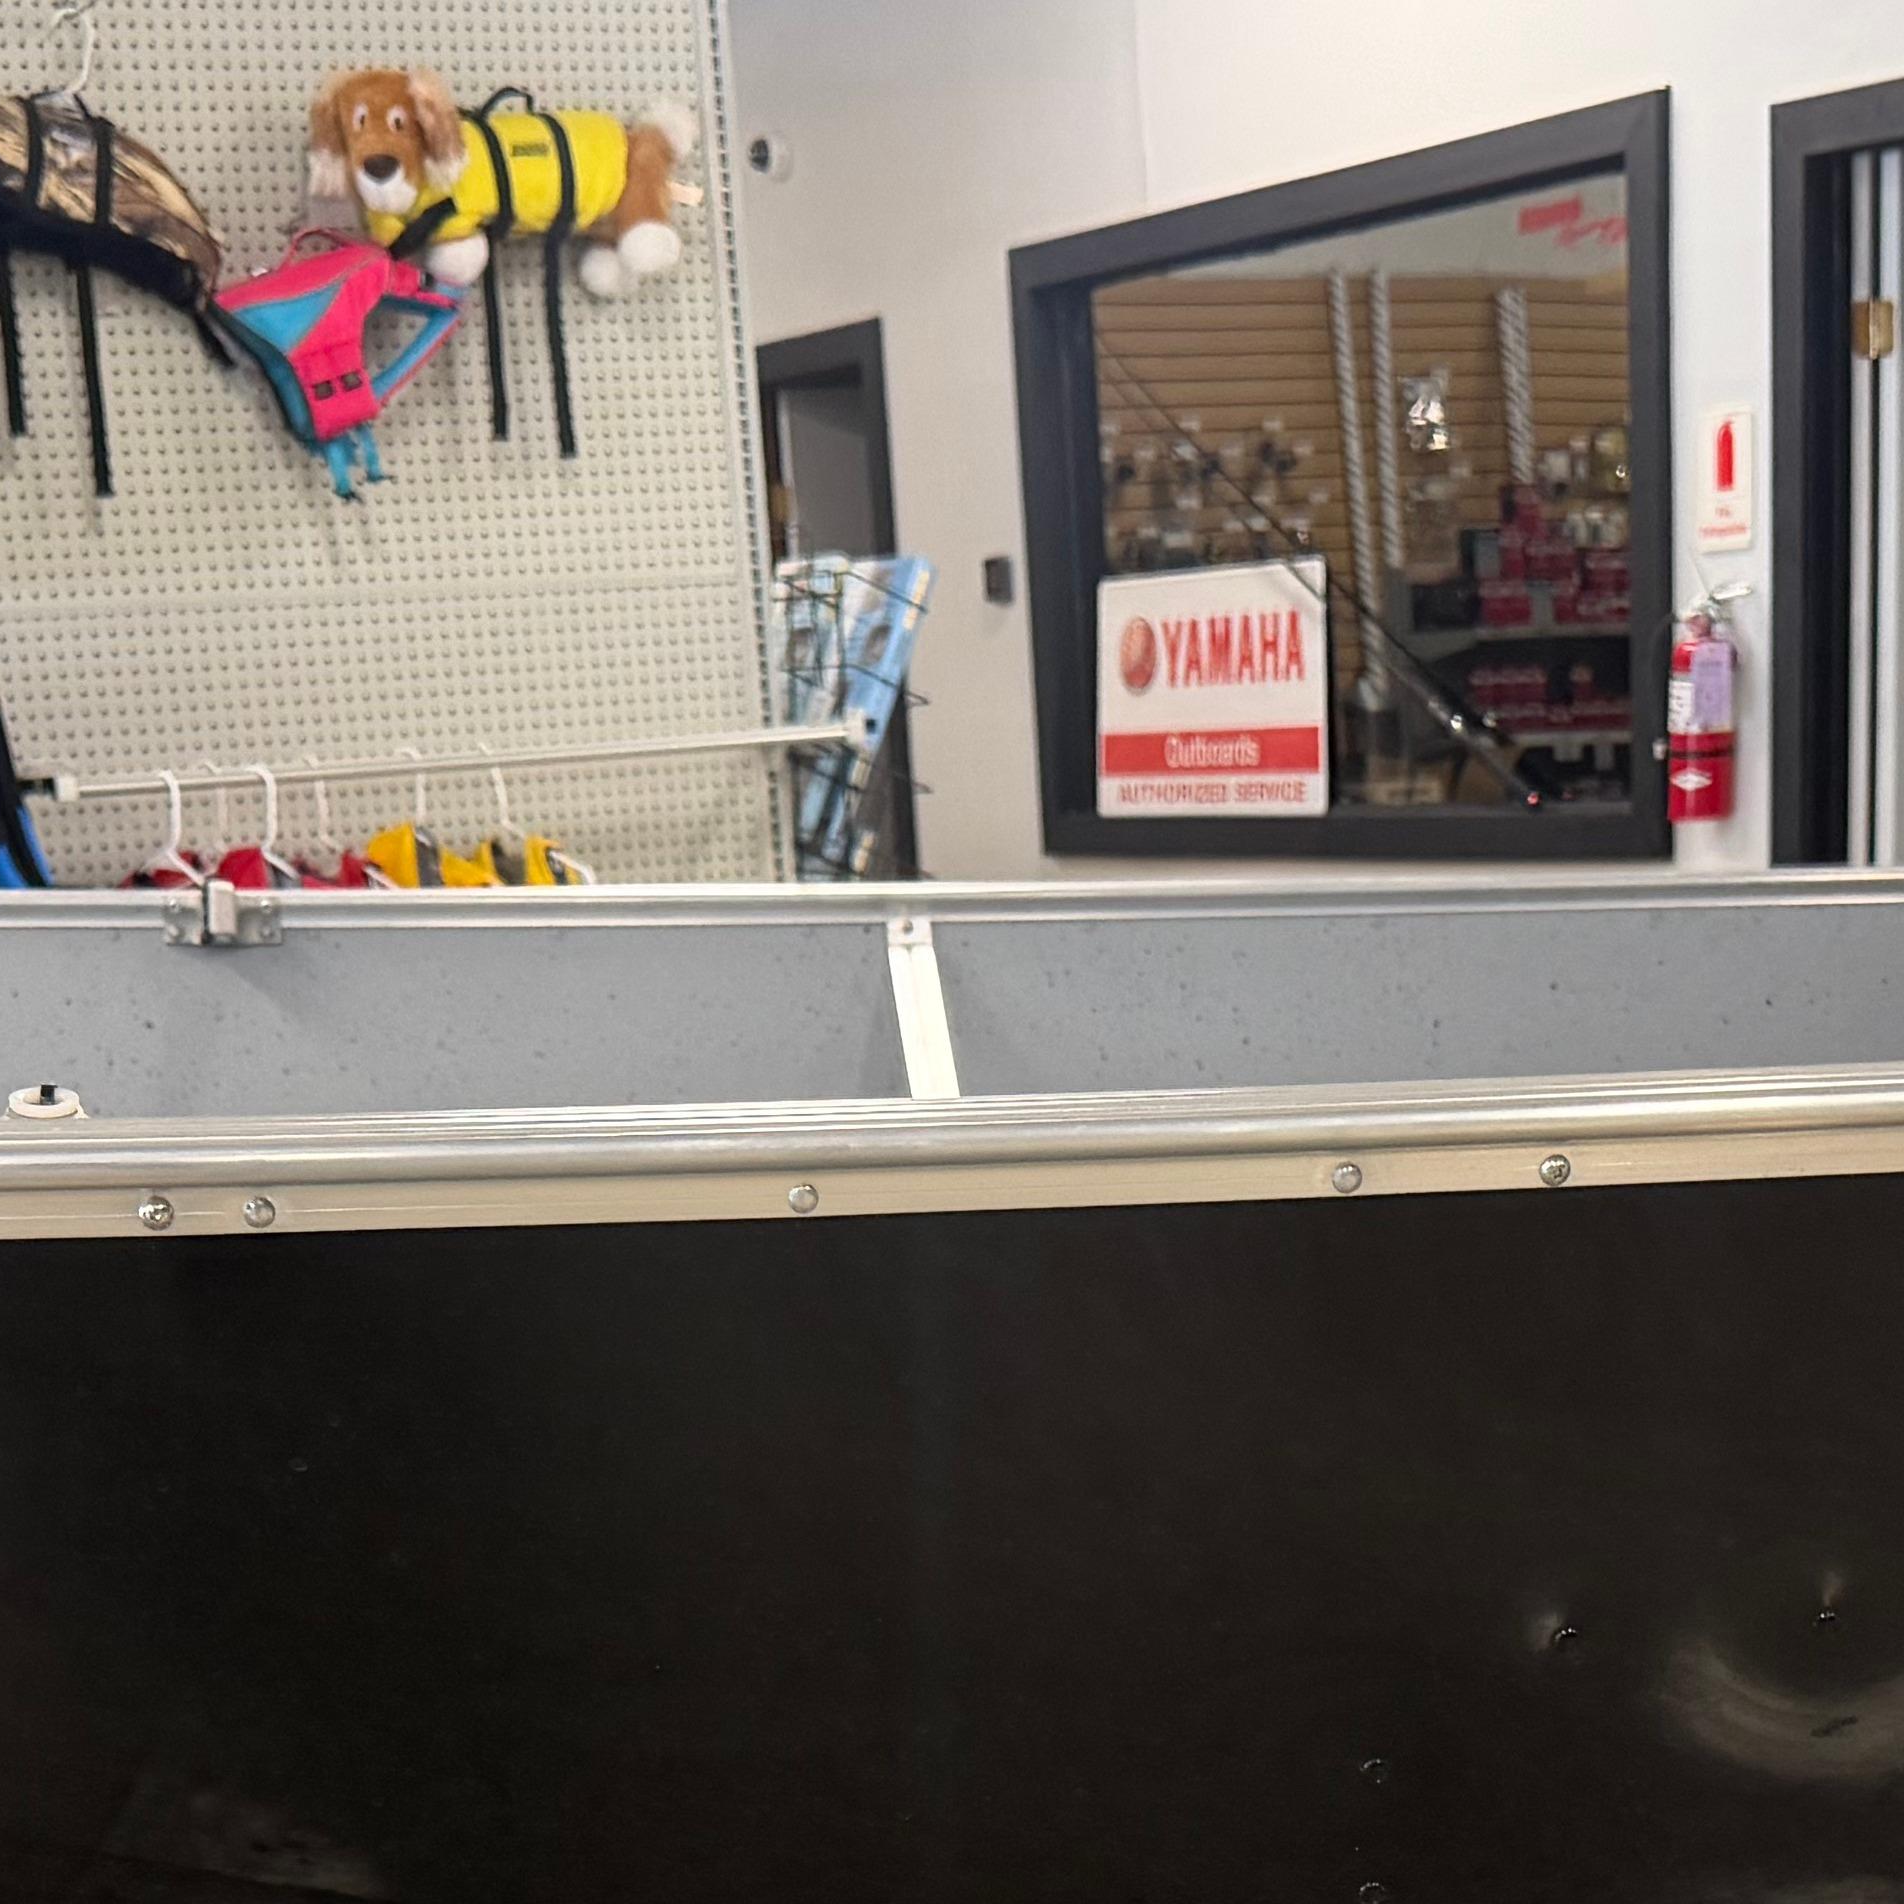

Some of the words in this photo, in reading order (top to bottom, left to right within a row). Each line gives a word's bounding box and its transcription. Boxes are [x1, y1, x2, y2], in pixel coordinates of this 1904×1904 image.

[1162, 611, 1304, 687] YAMAHA
[1165, 734, 1259, 768] Outboards
[1119, 782, 1228, 805] AUTHORIZED
[1234, 780, 1308, 804] SERVICE
